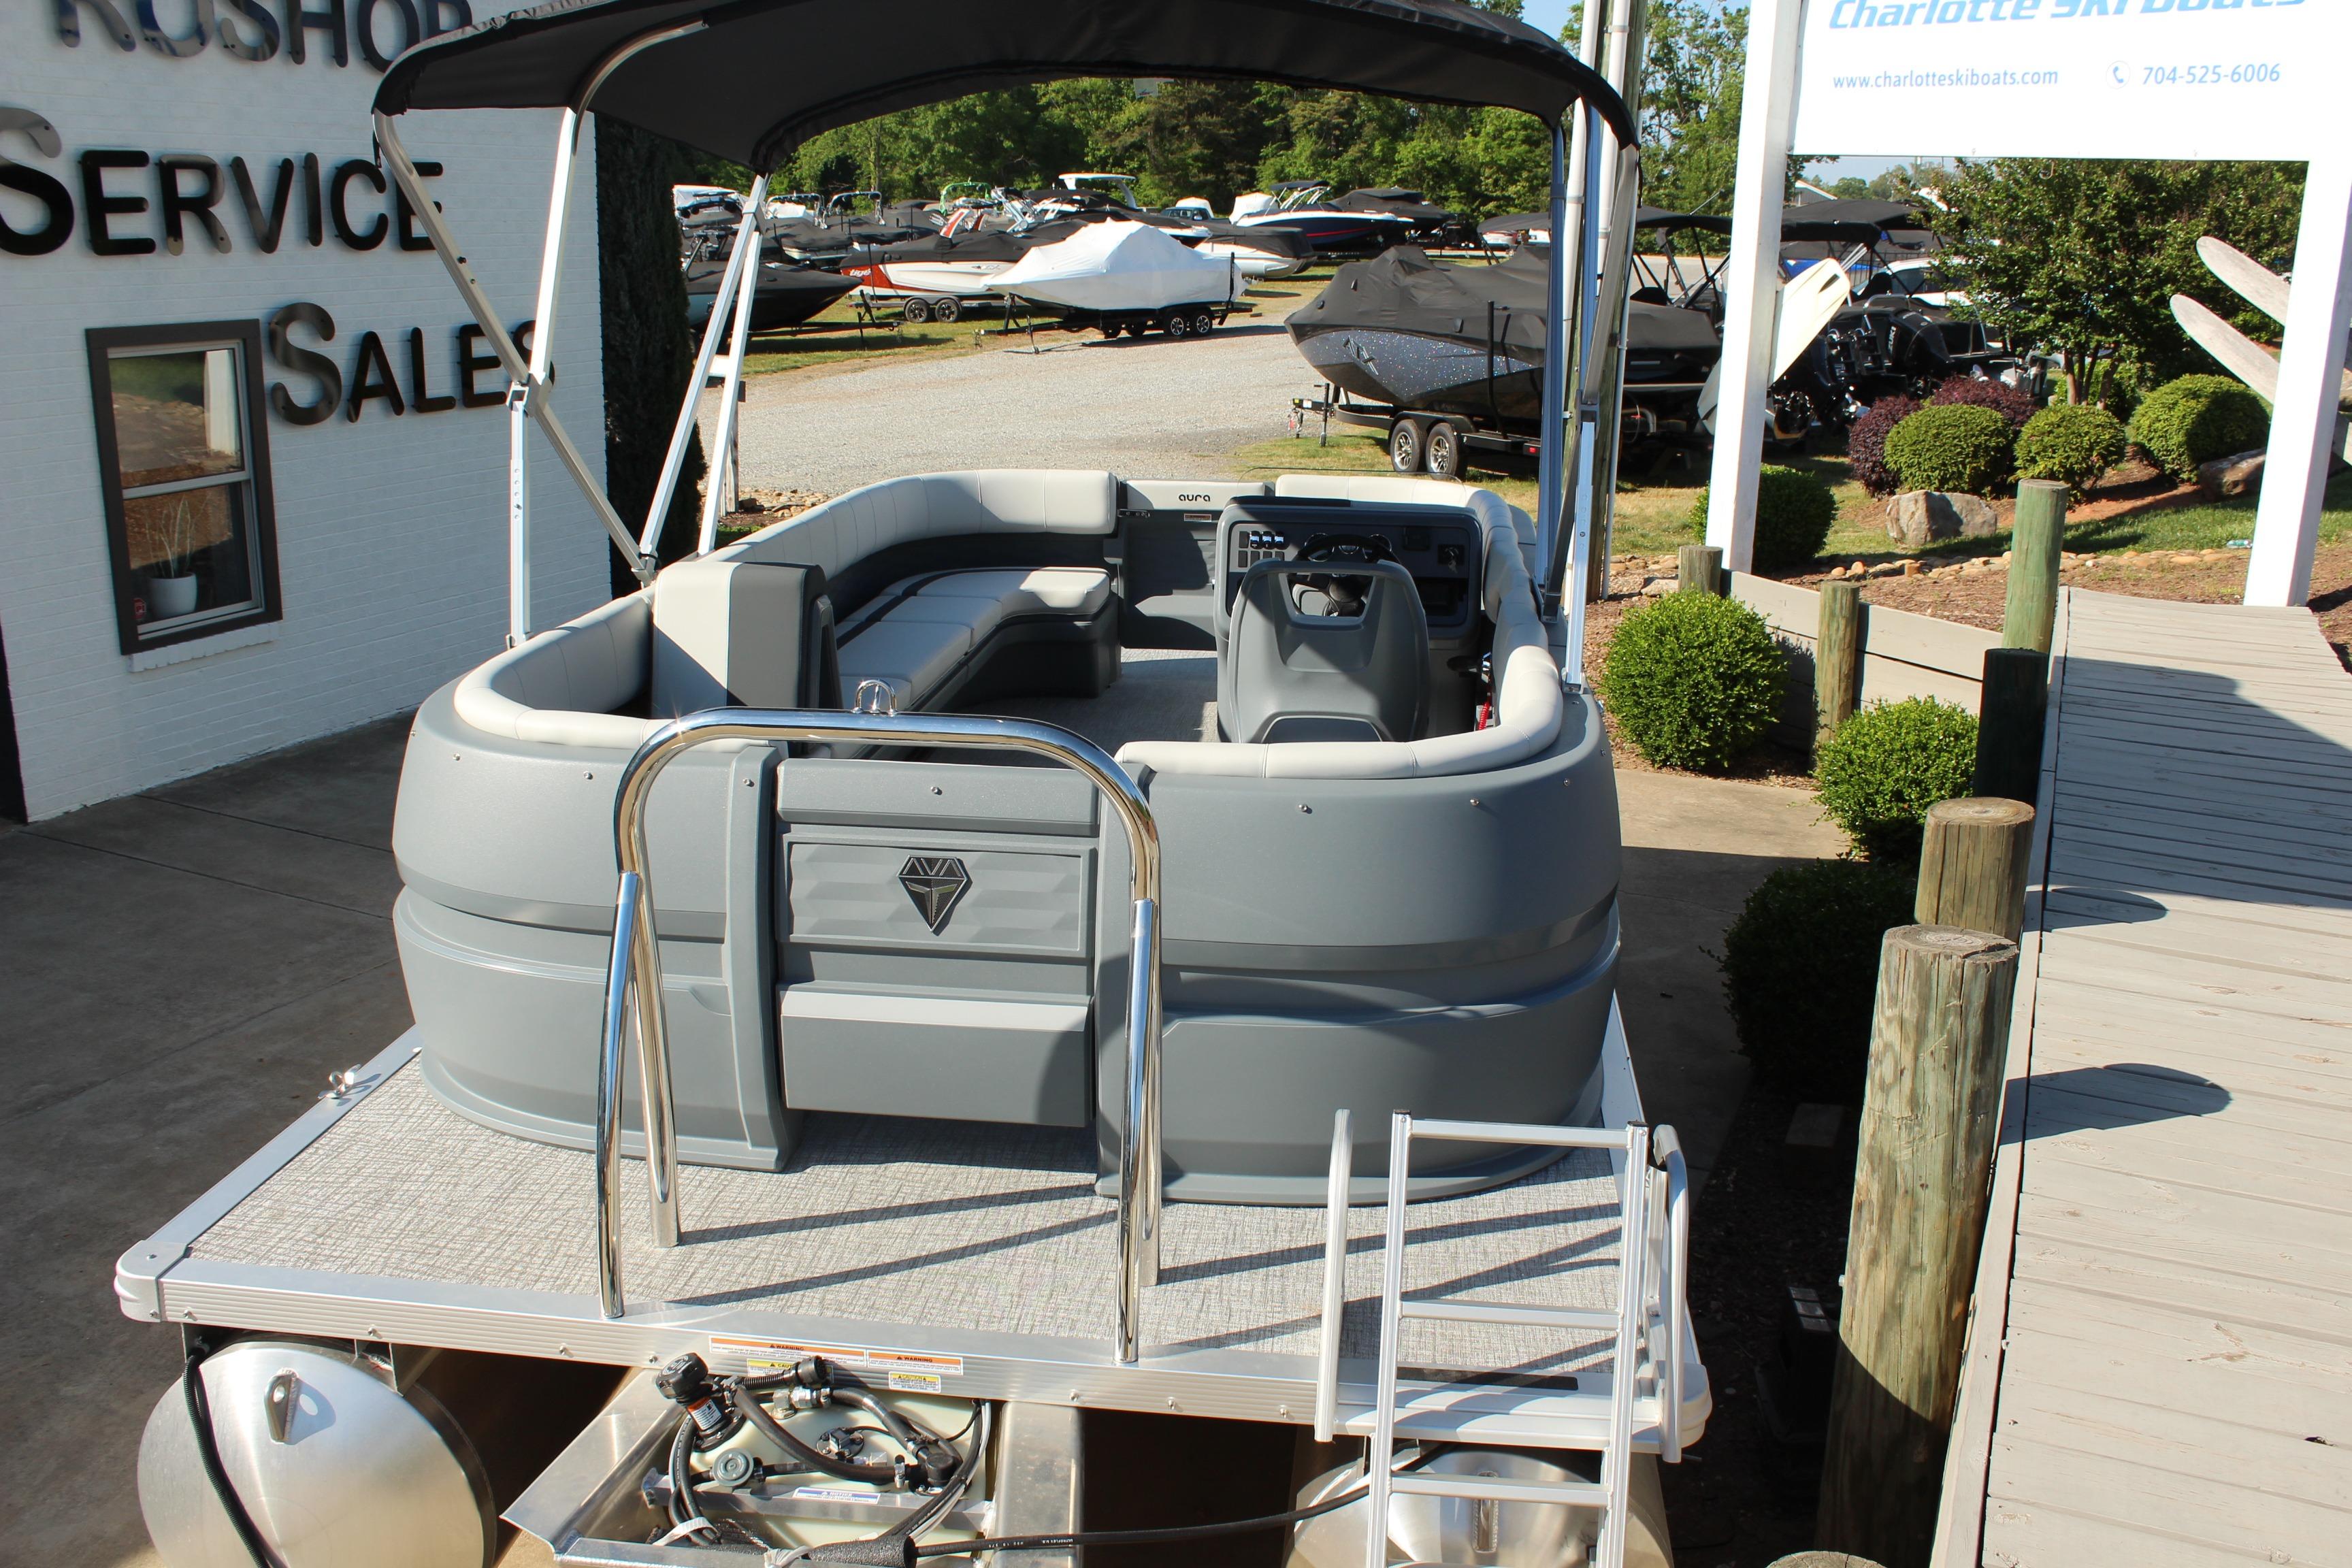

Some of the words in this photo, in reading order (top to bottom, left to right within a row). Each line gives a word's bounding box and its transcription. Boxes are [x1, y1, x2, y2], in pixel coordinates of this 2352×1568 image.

[1829, 0, 2042, 29] Charlotte
[1832, 68, 2059, 88] www.charlotteskiboats.com
[2142, 63, 2282, 86] 704-525-6006
[1178, 493, 1211, 502] aura
